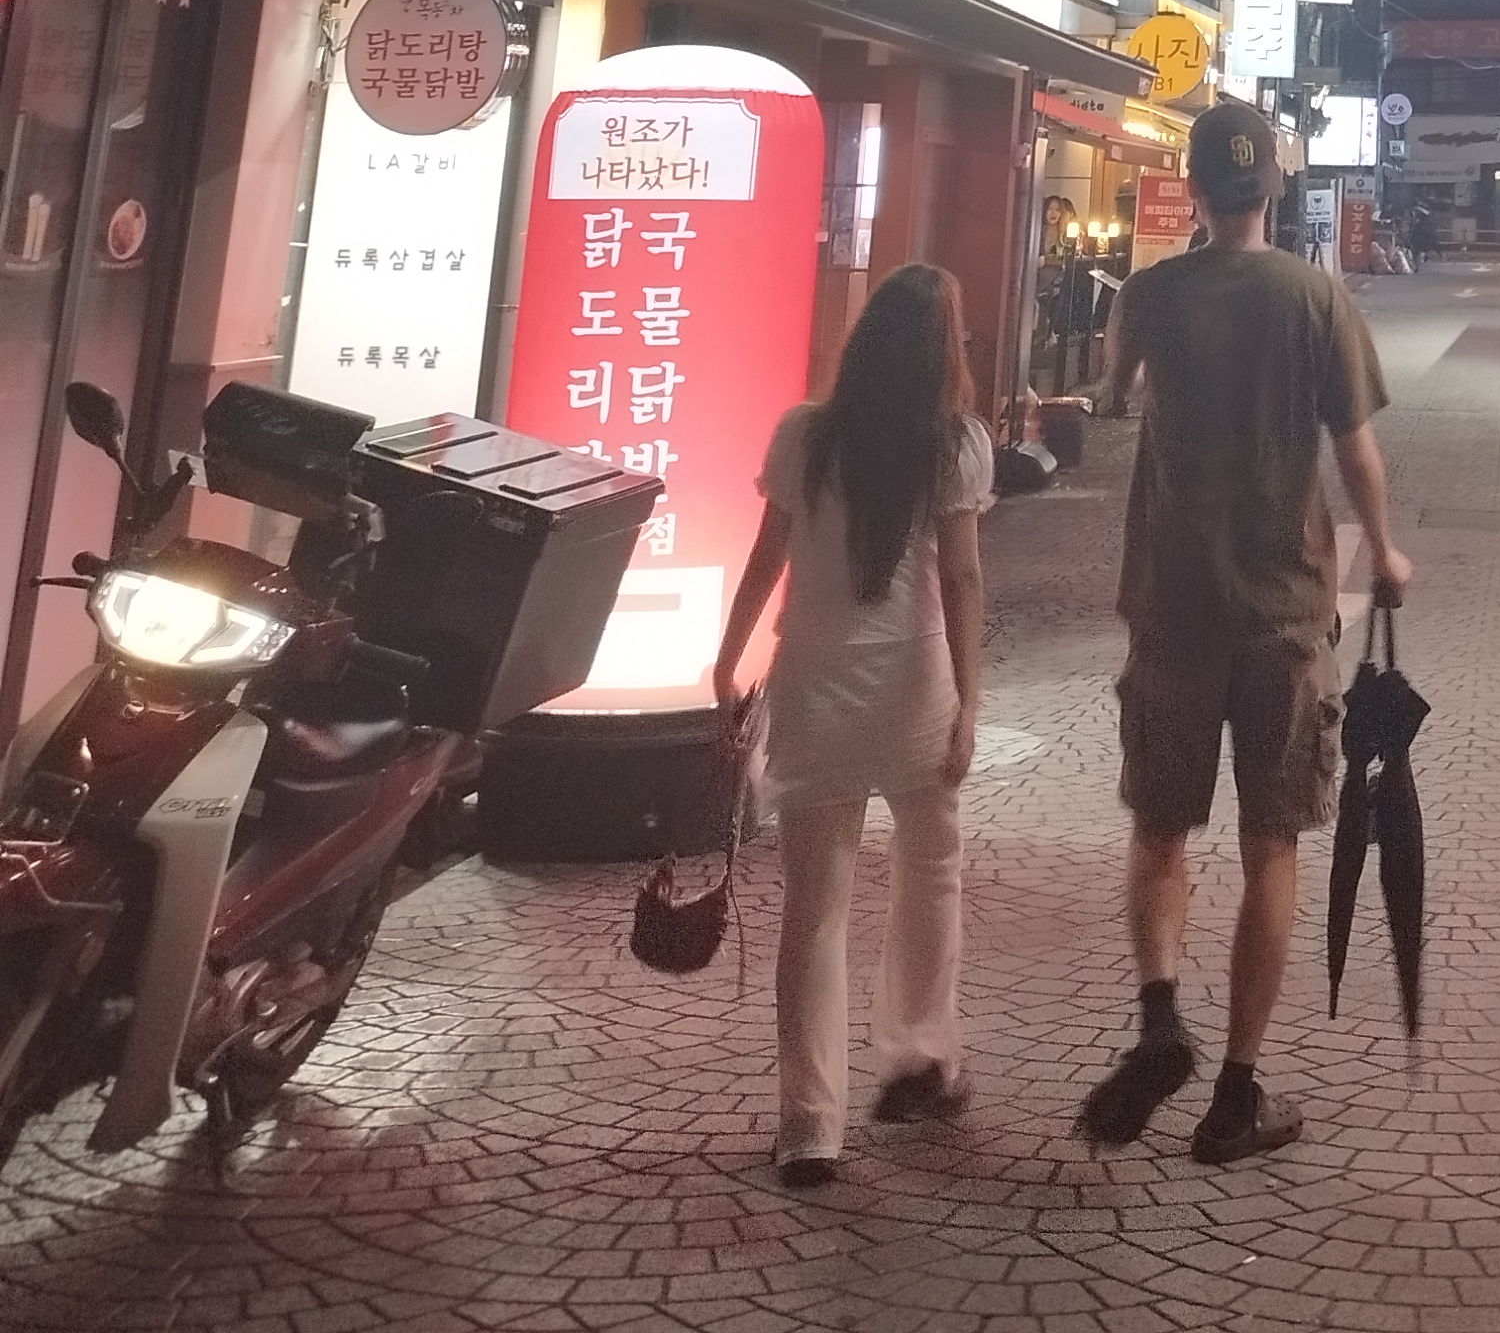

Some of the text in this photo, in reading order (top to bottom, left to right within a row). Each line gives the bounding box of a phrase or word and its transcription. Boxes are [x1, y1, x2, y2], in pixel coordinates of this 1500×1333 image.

[367, 29, 487, 65] 닭도리탕
[361, 67, 485, 101] 국물닭발
[601, 114, 695, 148] 원조가
[580, 157, 709, 192] 나타났다!
[334, 248, 467, 274] 듀록삼겹살
[337, 345, 441, 370] 듀록목살
